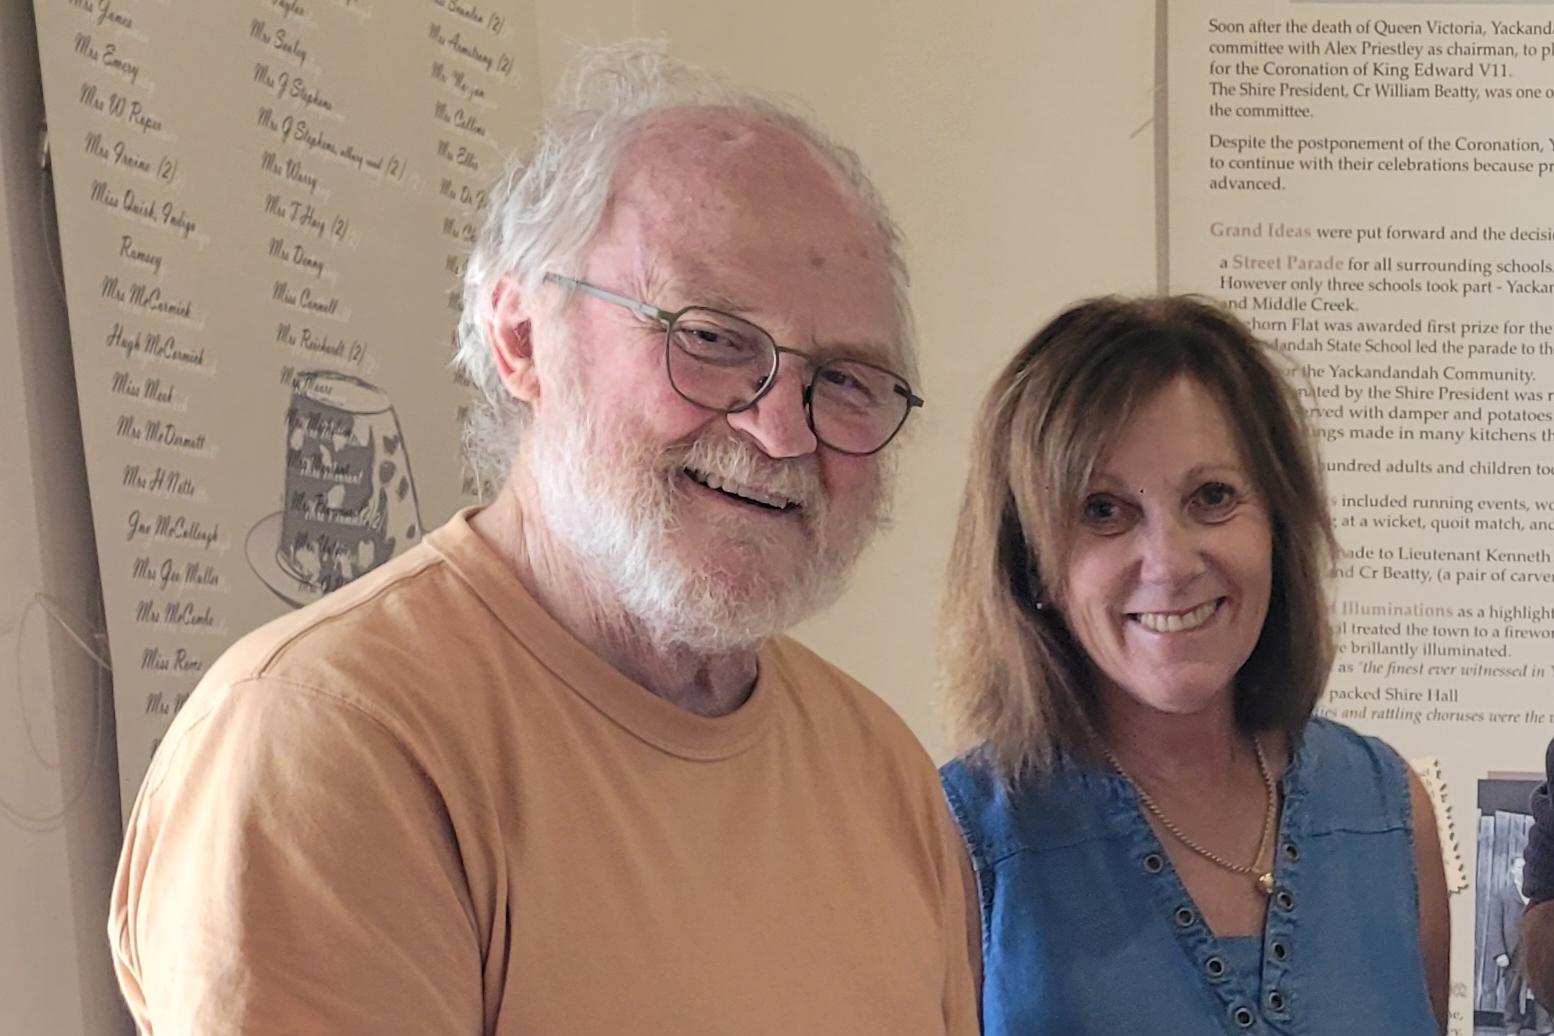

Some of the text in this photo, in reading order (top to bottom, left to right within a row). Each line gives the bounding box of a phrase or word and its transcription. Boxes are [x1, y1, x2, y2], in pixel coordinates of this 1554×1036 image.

[1207, 18, 1245, 34] Soon
[1248, 18, 1283, 35] after
[1285, 18, 1309, 35] the
[1310, 19, 1353, 35] death
[1355, 19, 1372, 35] of
[1373, 19, 1423, 38] Queen
[1425, 19, 1488, 37] Victoria,
[1208, 40, 1285, 56] committee
[1287, 39, 1321, 56] with
[1323, 40, 1358, 56] Alex
[1361, 40, 1424, 60] Priestley
[1427, 45, 1444, 57] as
[1446, 40, 1519, 59] chairman,
[1522, 43, 1538, 57] to
[1208, 134, 1267, 154] Despite
[1269, 134, 1294, 150] the
[1297, 136, 1405, 154] postponement
[1407, 135, 1425, 152] of
[1427, 135, 1452, 152] the
[1454, 135, 1545, 154] Coronation,
[157, 155, 178, 185] (2)
[331, 213, 349, 242] (2)
[1209, 222, 1263, 238] Grand
[1268, 222, 1312, 239] Ideas
[1316, 227, 1353, 240] were
[1356, 226, 1382, 243] put
[1386, 224, 1446, 241] forward
[1449, 225, 1478, 241] and
[1482, 225, 1507, 241] the
[1218, 258, 1229, 270] a
[1232, 254, 1282, 271] Street
[1287, 255, 1345, 271] Parade
[1347, 256, 1371, 272] for
[1373, 256, 1393, 273] all
[1396, 257, 1493, 277] surrounding
[1252, 295, 1308, 312] Middle
[1310, 296, 1360, 312] Creek.
[349, 339, 367, 366] (2)
[1343, 384, 1364, 404] by
[1367, 384, 1392, 400] the
[1394, 384, 1435, 401] Shire
[1438, 385, 1510, 402] President
[1513, 391, 1544, 402] was
[1329, 686, 1459, 703] packed Shire Hall
